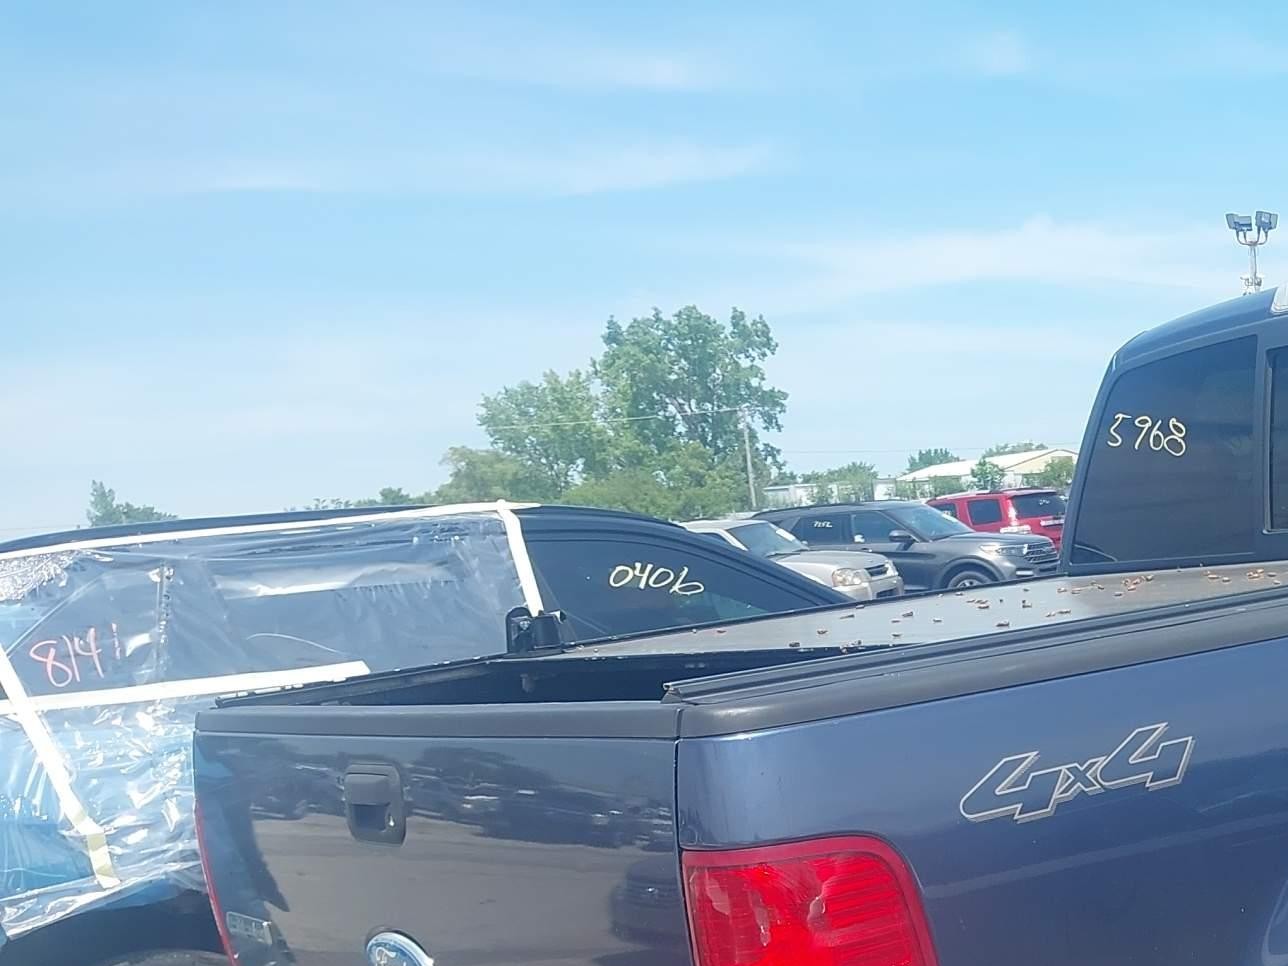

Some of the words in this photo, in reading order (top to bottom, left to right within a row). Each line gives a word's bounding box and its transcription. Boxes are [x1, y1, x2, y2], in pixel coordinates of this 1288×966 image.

[1107, 413, 1186, 456] 5968
[609, 562, 704, 595] 0406
[959, 722, 1196, 824] 4x4
